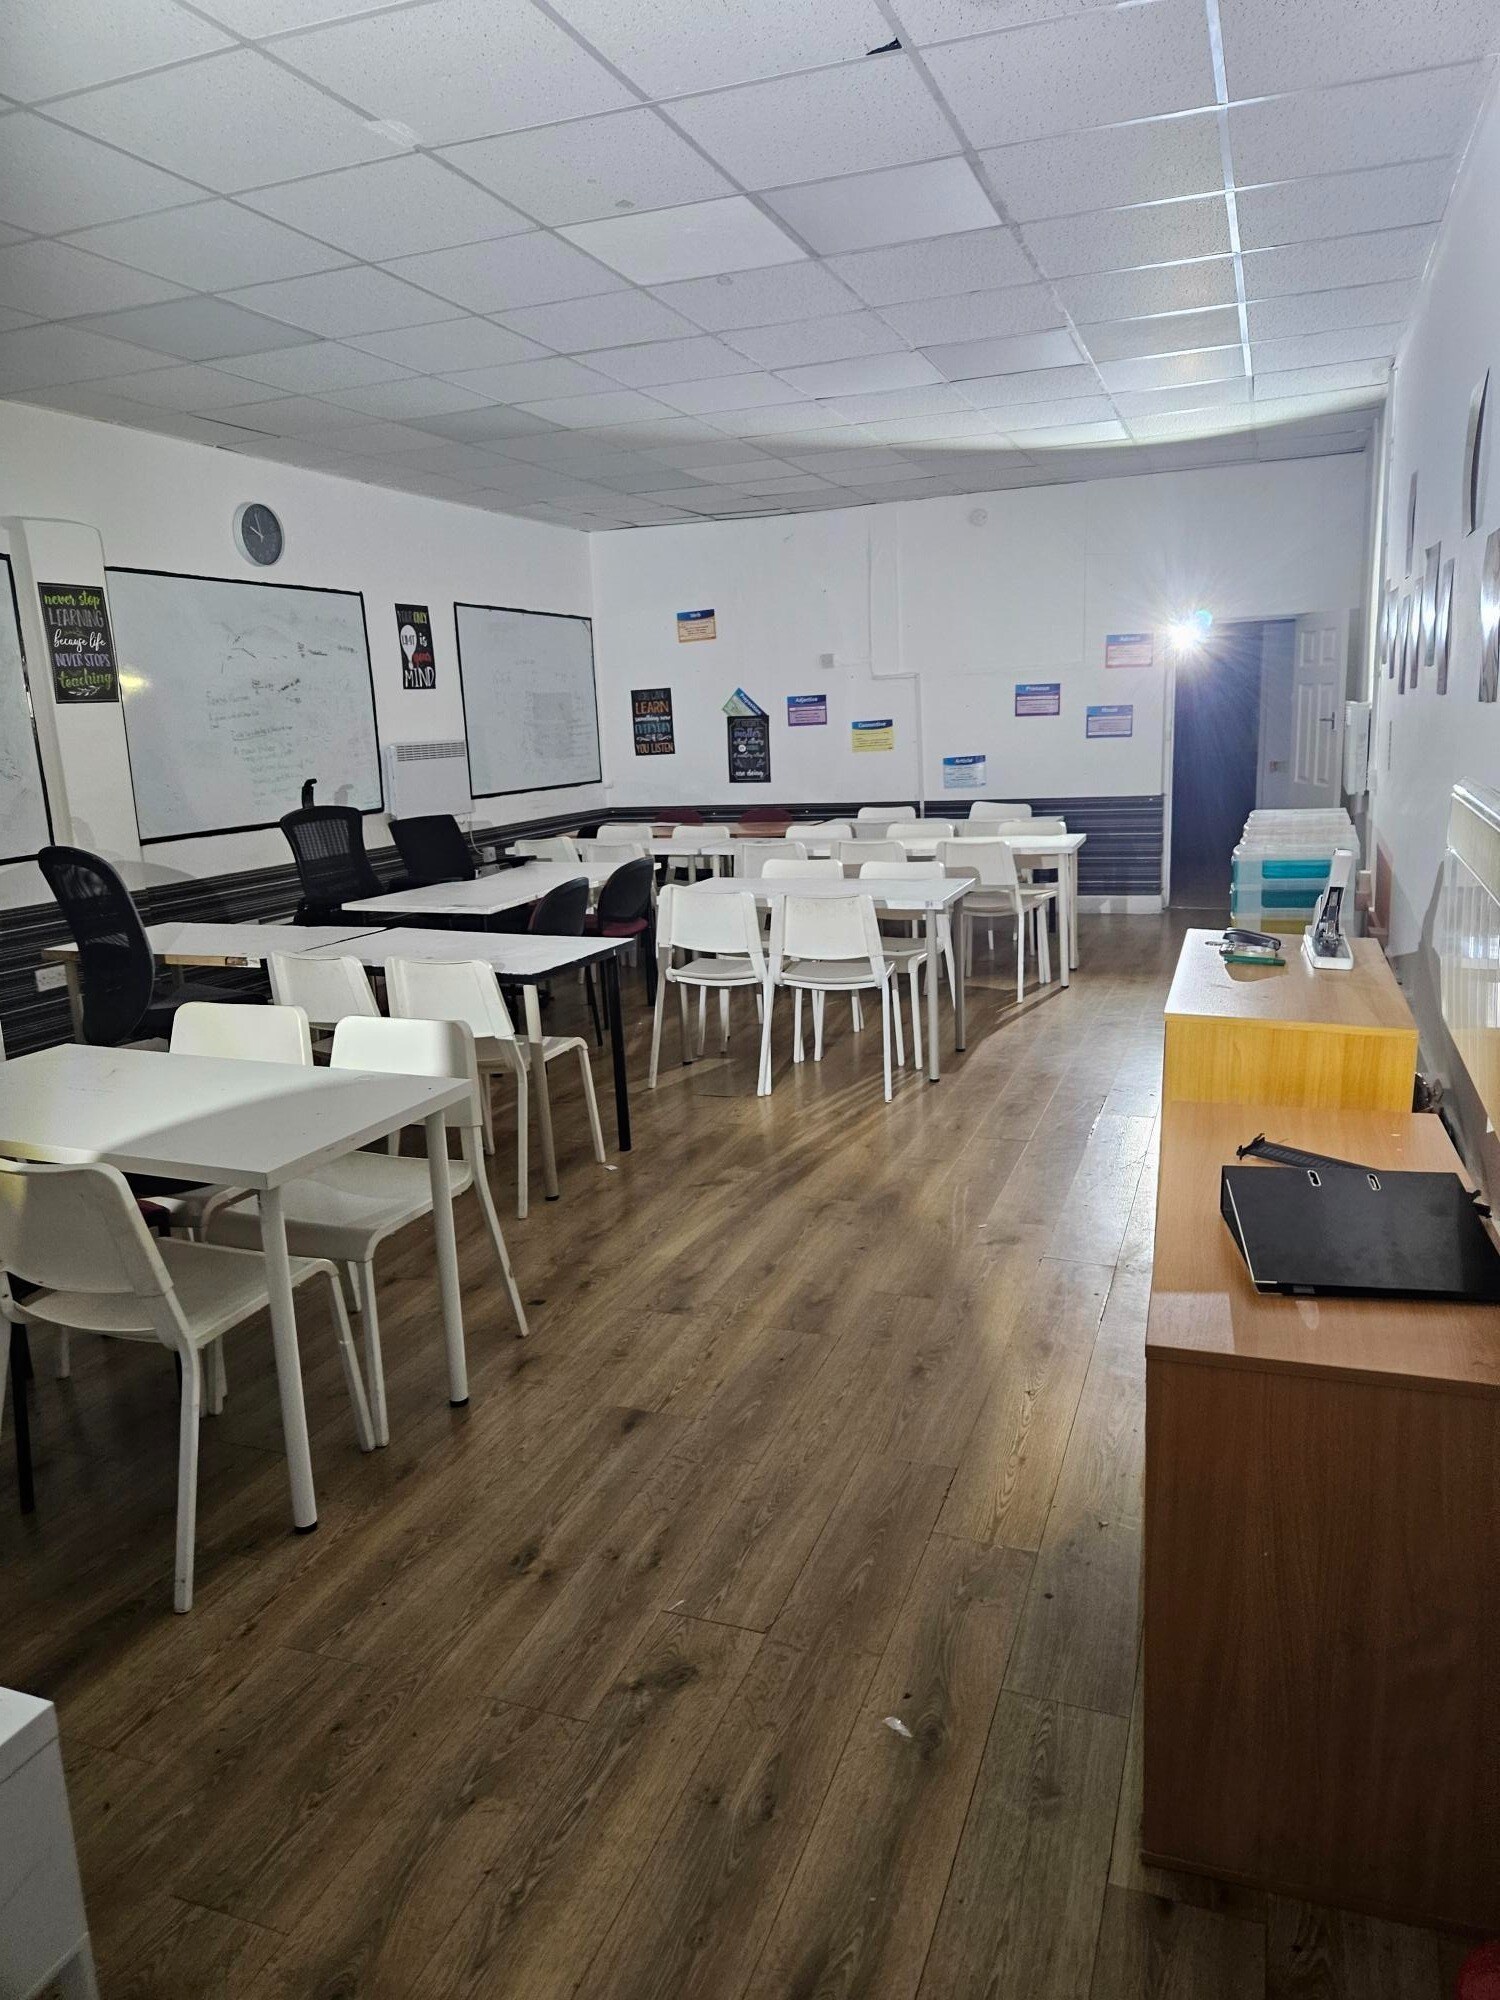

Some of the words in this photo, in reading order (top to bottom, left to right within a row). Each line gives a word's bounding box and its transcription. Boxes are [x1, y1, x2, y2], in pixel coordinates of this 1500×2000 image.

[44, 594, 76, 606] never
[78, 590, 101, 609] stop
[48, 607, 105, 628] LEARNING
[54, 628, 88, 652] because
[89, 632, 106, 651] life
[419, 632, 428, 647] is
[55, 653, 83, 667] NEVER
[84, 653, 111, 667] STOPS
[59, 668, 113, 690] teaching
[404, 666, 435, 688] MIND
[635, 700, 669, 714] LEARN
[636, 742, 649, 754] YOU
[651, 741, 674, 753] LISTEN
